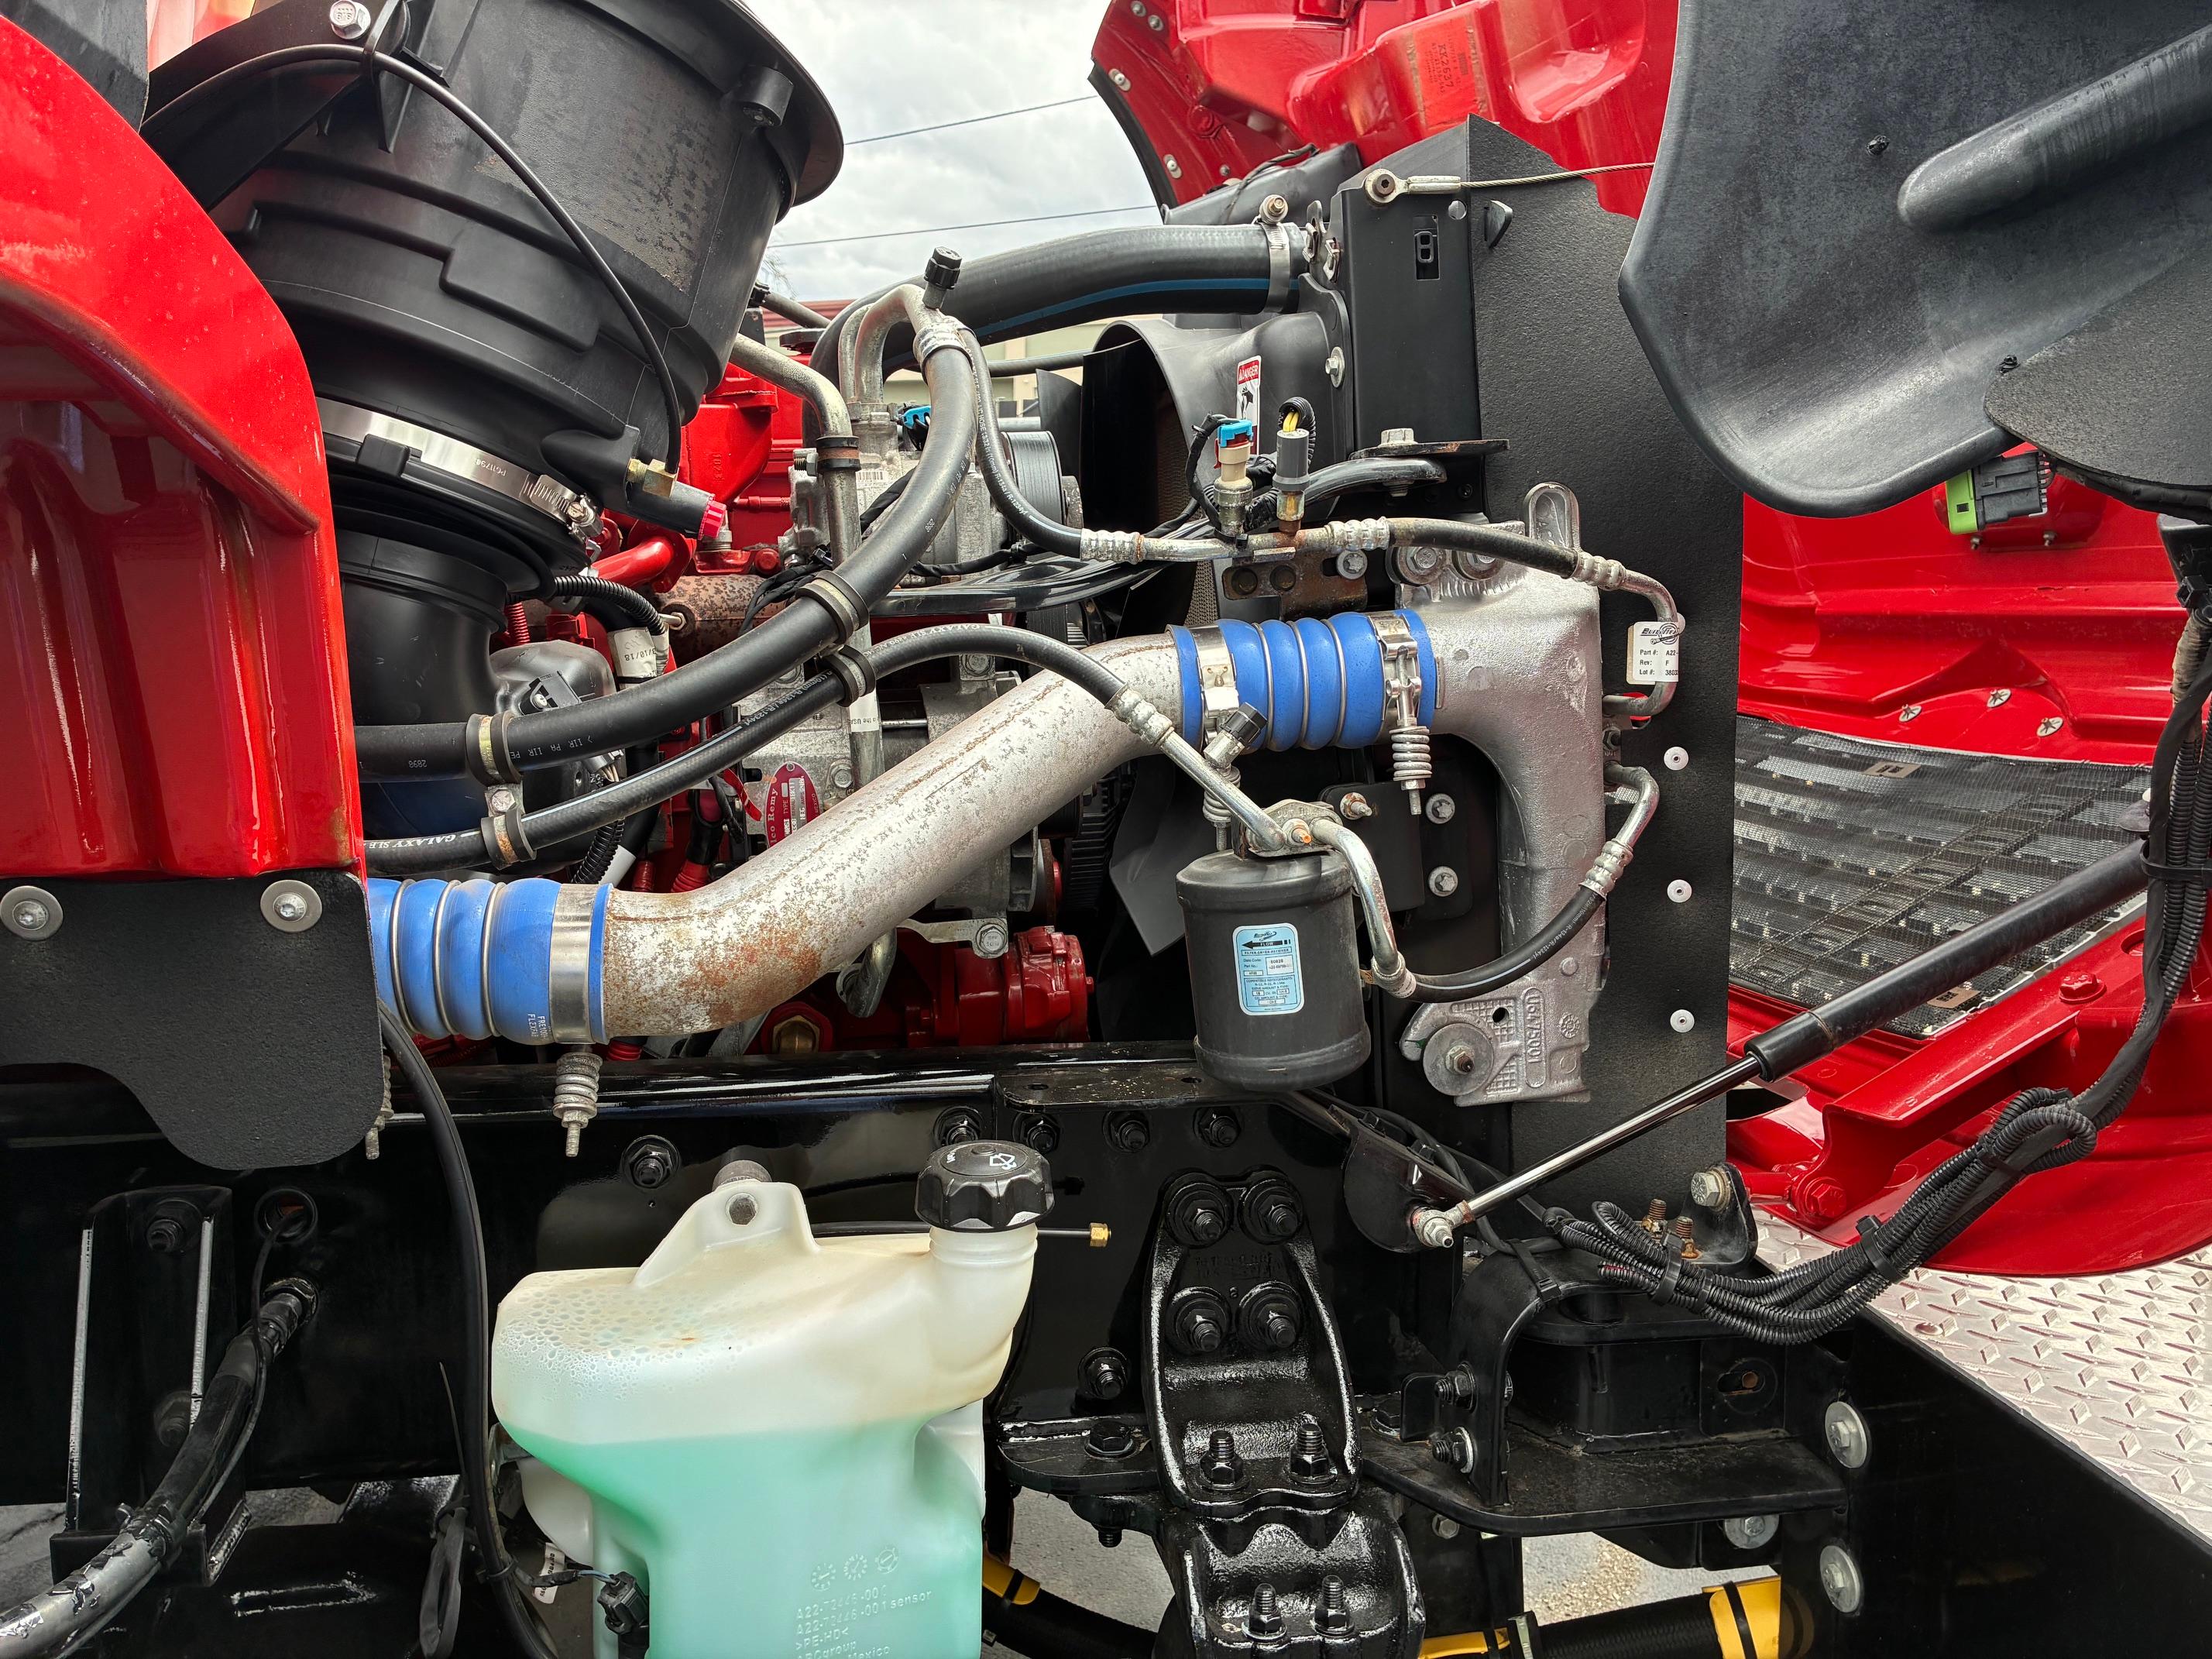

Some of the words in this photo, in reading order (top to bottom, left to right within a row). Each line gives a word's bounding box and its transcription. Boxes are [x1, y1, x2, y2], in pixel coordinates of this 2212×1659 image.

[929, 624, 981, 635] GALAXY
[768, 788, 778, 821] Remy
[392, 834, 456, 848] GALAXY
[890, 1590, 932, 1609] sensor
[797, 1640, 857, 1659] BCgroup
